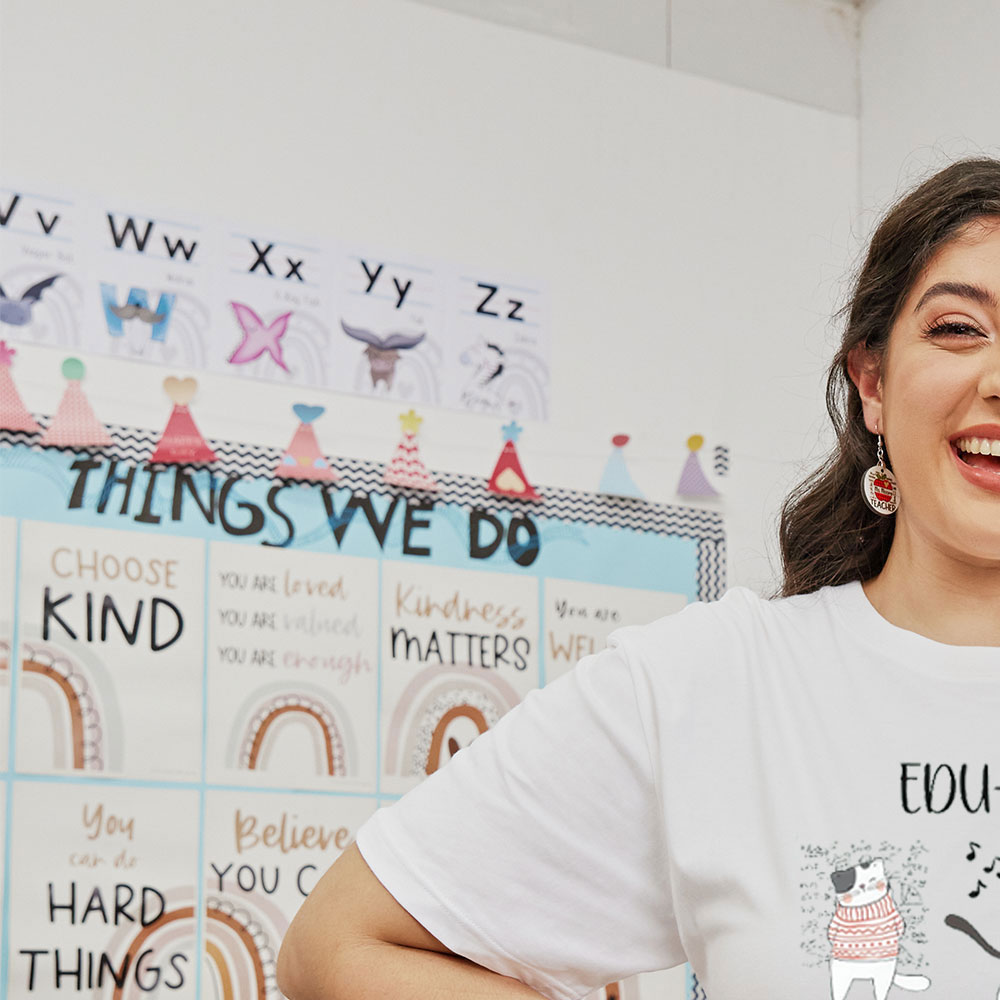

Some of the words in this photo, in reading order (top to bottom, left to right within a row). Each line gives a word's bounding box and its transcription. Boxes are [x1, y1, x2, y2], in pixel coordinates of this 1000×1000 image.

[67, 457, 296, 548] THINGS
[321, 484, 434, 557] WE
[468, 509, 541, 567] DO
[51, 548, 179, 589] CHOOSE
[219, 571, 248, 590] YOU
[253, 574, 277, 593] ARE
[283, 568, 347, 601] loved
[43, 586, 185, 652] KIND
[218, 608, 248, 627] YOU
[395, 580, 528, 630] Kindness
[217, 645, 247, 664] YOU
[82, 803, 135, 841] You
[234, 809, 351, 856] Believe
[69, 852, 104, 868] can
[113, 849, 138, 868] do
[211, 862, 280, 895] YOU
[48, 881, 166, 928] HARD
[20, 948, 189, 992] THINGS
